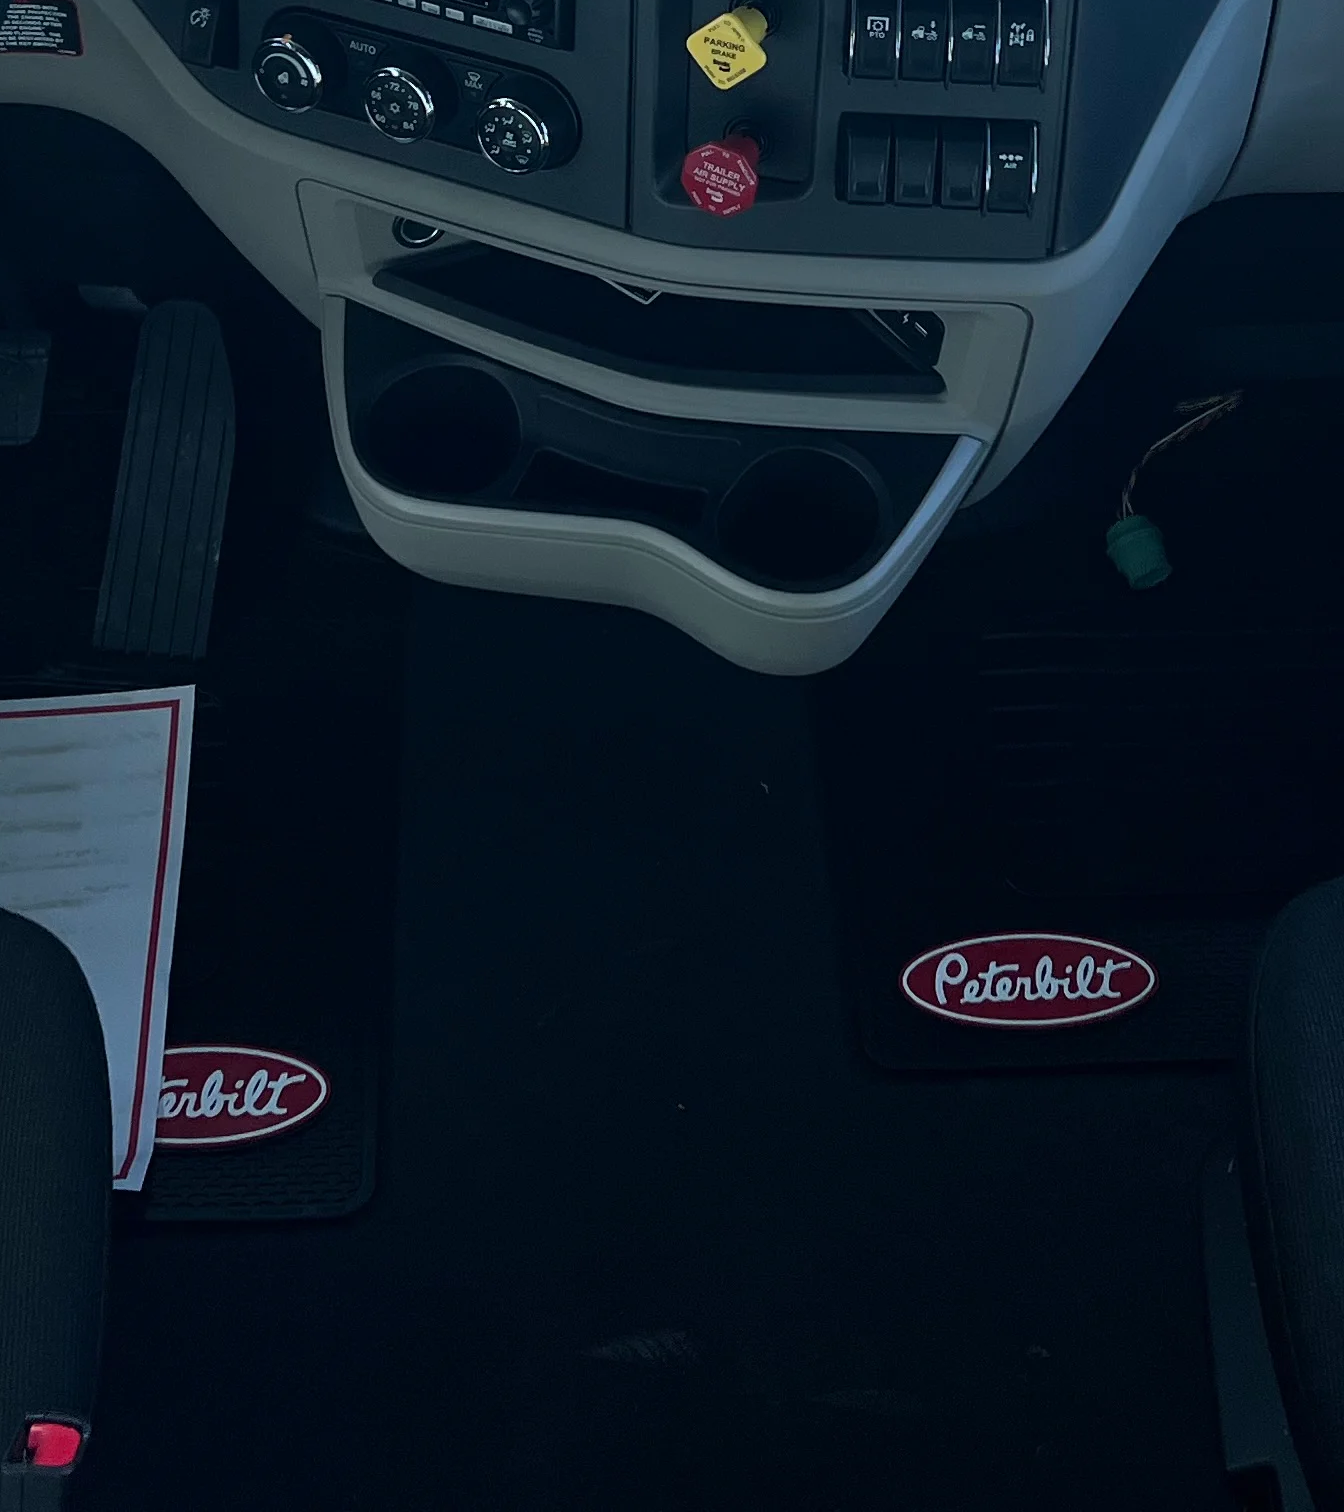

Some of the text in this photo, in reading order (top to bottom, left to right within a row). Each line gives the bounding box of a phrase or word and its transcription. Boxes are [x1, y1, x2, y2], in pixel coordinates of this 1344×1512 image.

[869, 30, 885, 39] PTO
[349, 40, 376, 55] AUTO
[704, 36, 745, 53] PARKING
[711, 48, 736, 59] BRAKE
[389, 81, 400, 92] 72
[464, 79, 483, 90] MAX
[703, 161, 740, 181] TRAILER
[693, 167, 746, 192] AIR SUPPLY
[935, 952, 1132, 1005] Peterbilt
[157, 1069, 307, 1118] erbilt
